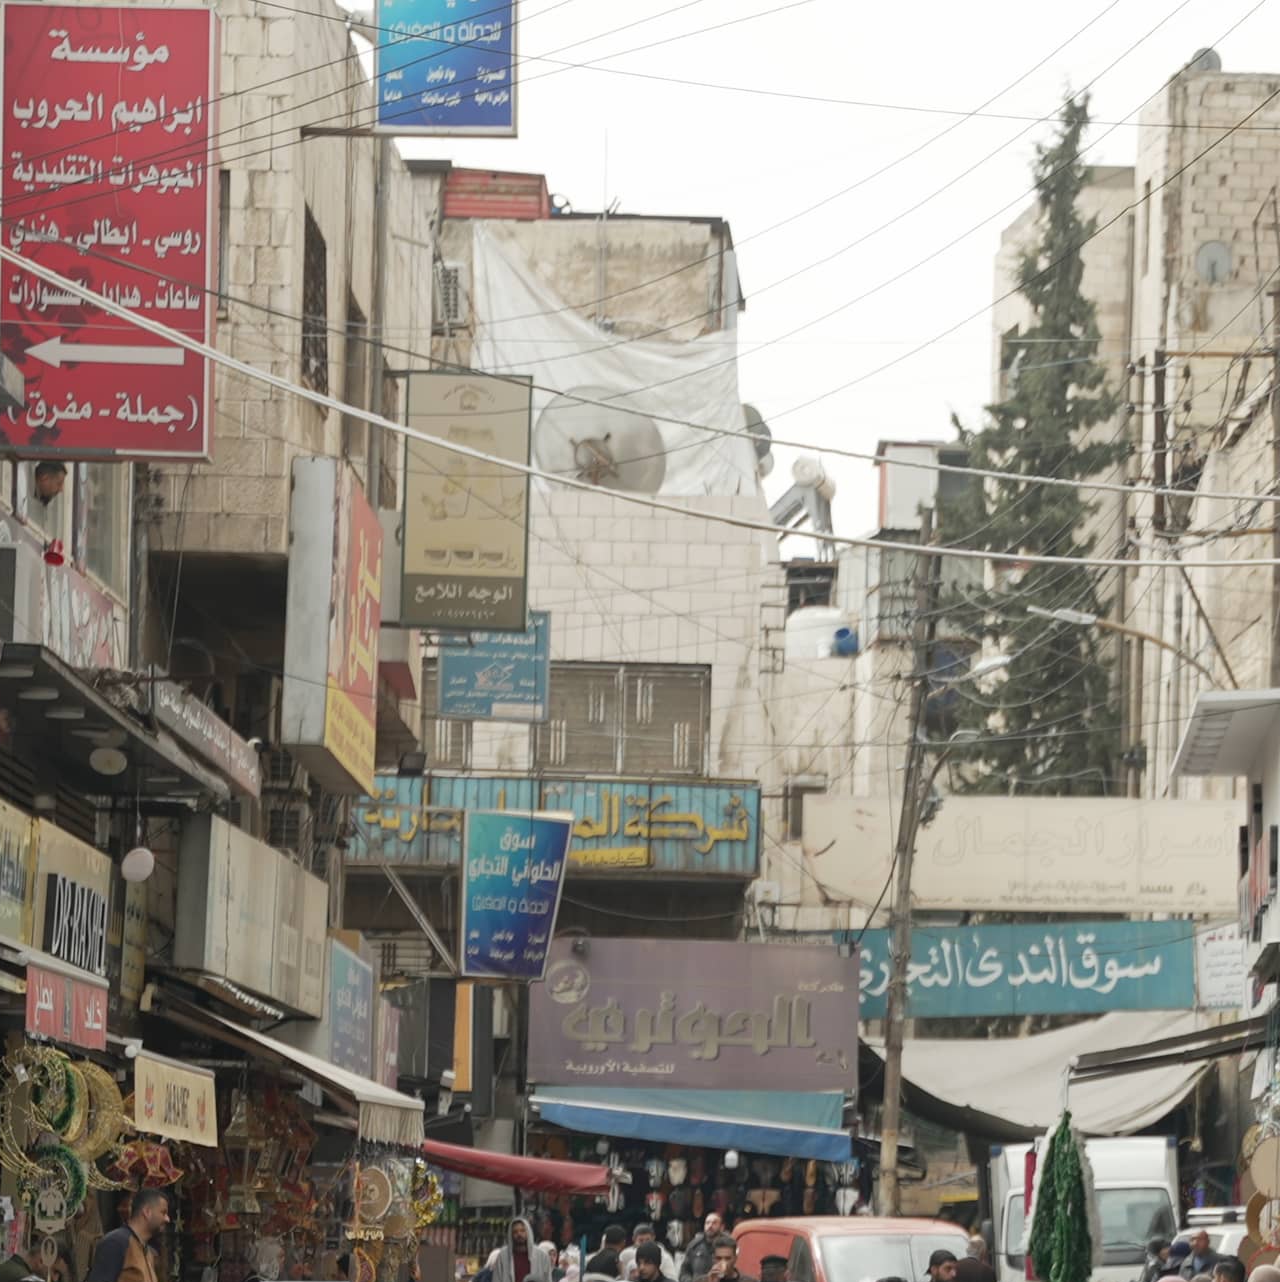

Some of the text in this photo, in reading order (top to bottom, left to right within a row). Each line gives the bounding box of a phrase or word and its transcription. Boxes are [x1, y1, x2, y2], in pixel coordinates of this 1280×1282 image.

[48, 29, 169, 71] مؤسسة
[13, 91, 202, 135] ابراهيم الحروب
[11, 152, 202, 194] المجوهرات التقليدية
[9, 213, 201, 258] روسي ايطالي هندي
[155, 279, 201, 311] ساعات
[414, 583, 513, 603] الوجه اللامع
[499, 826, 536, 850] سوق
[624, 792, 748, 855] شركة
[511, 857, 560, 887] الحلواني
[858, 935, 965, 1002] التجري
[1068, 929, 1163, 993] سوق
